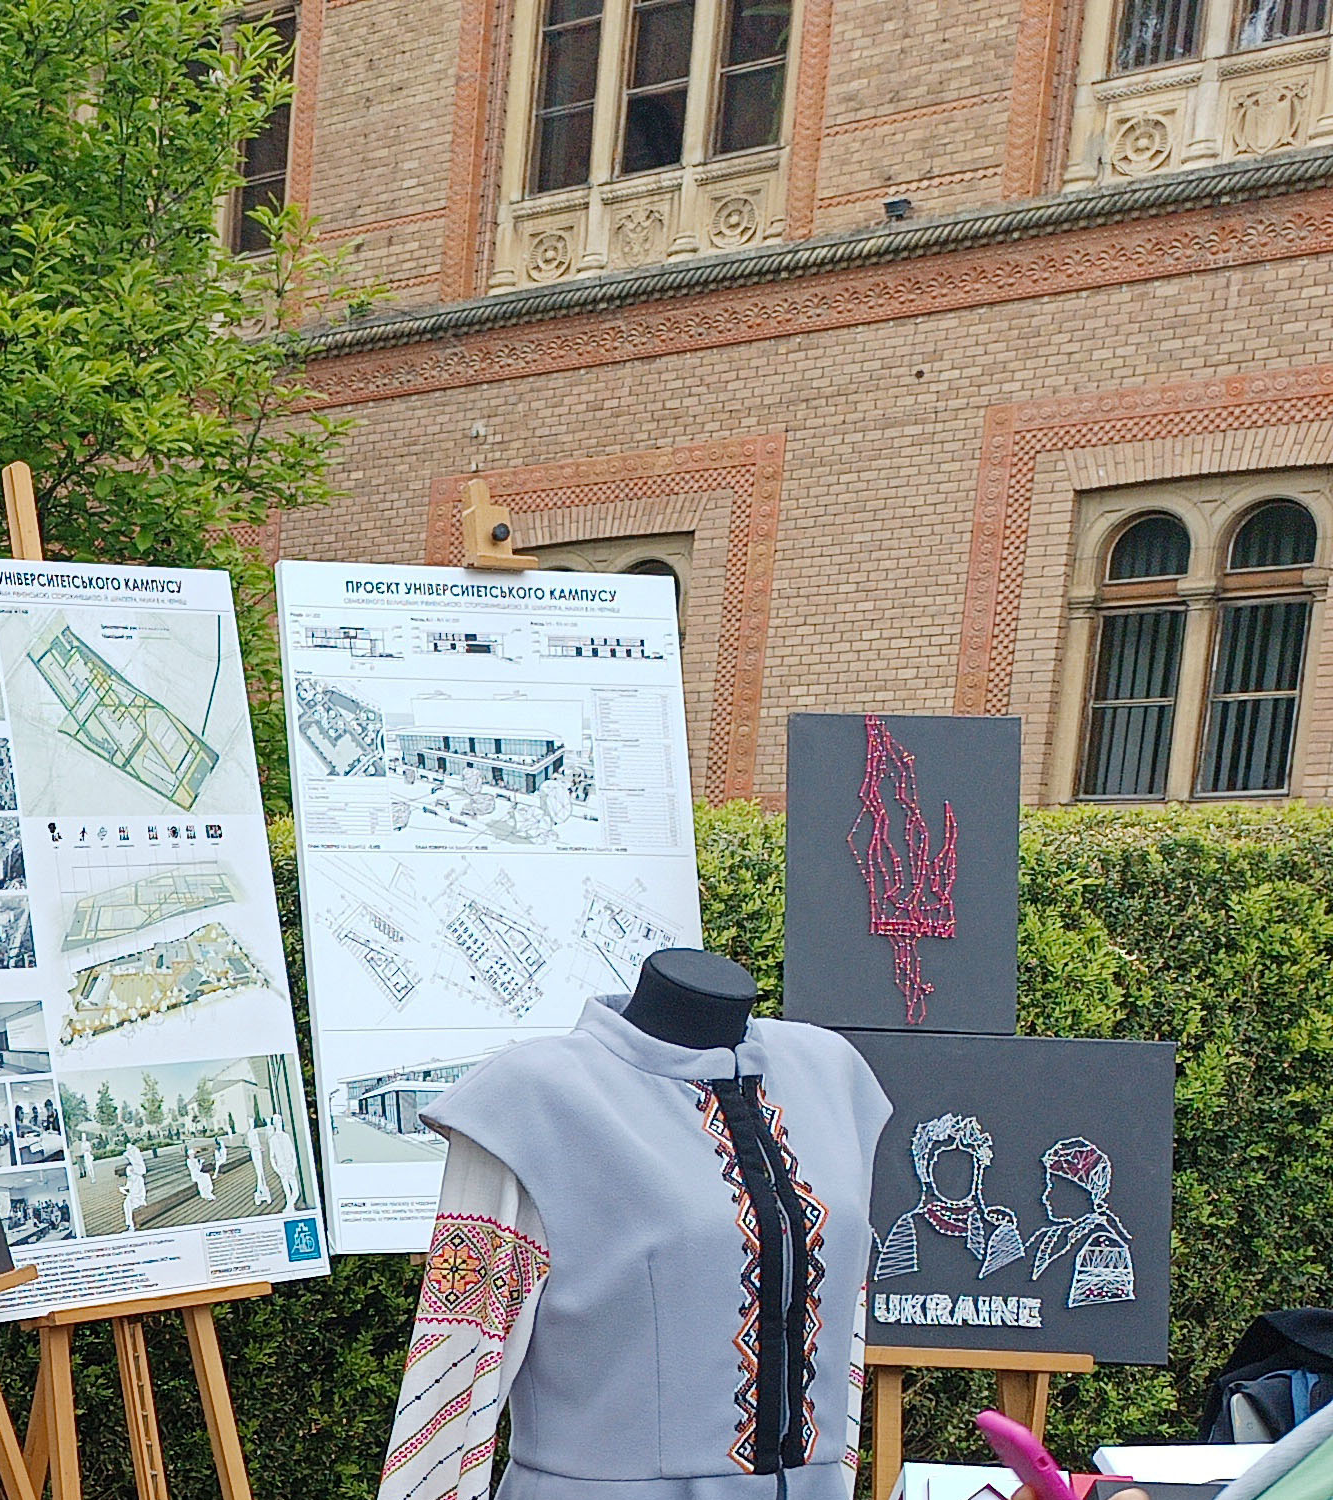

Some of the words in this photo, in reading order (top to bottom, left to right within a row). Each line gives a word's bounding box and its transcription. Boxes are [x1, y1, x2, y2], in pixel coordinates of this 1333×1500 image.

[124, 578, 182, 594] КАМПУСУ
[345, 581, 400, 595] ПРОЄКТ
[404, 582, 545, 600] УНІВЕРСИТЕТСЬКОГО
[549, 587, 617, 602] КАМПУСУ
[874, 1293, 1042, 1328] UKRAINE
